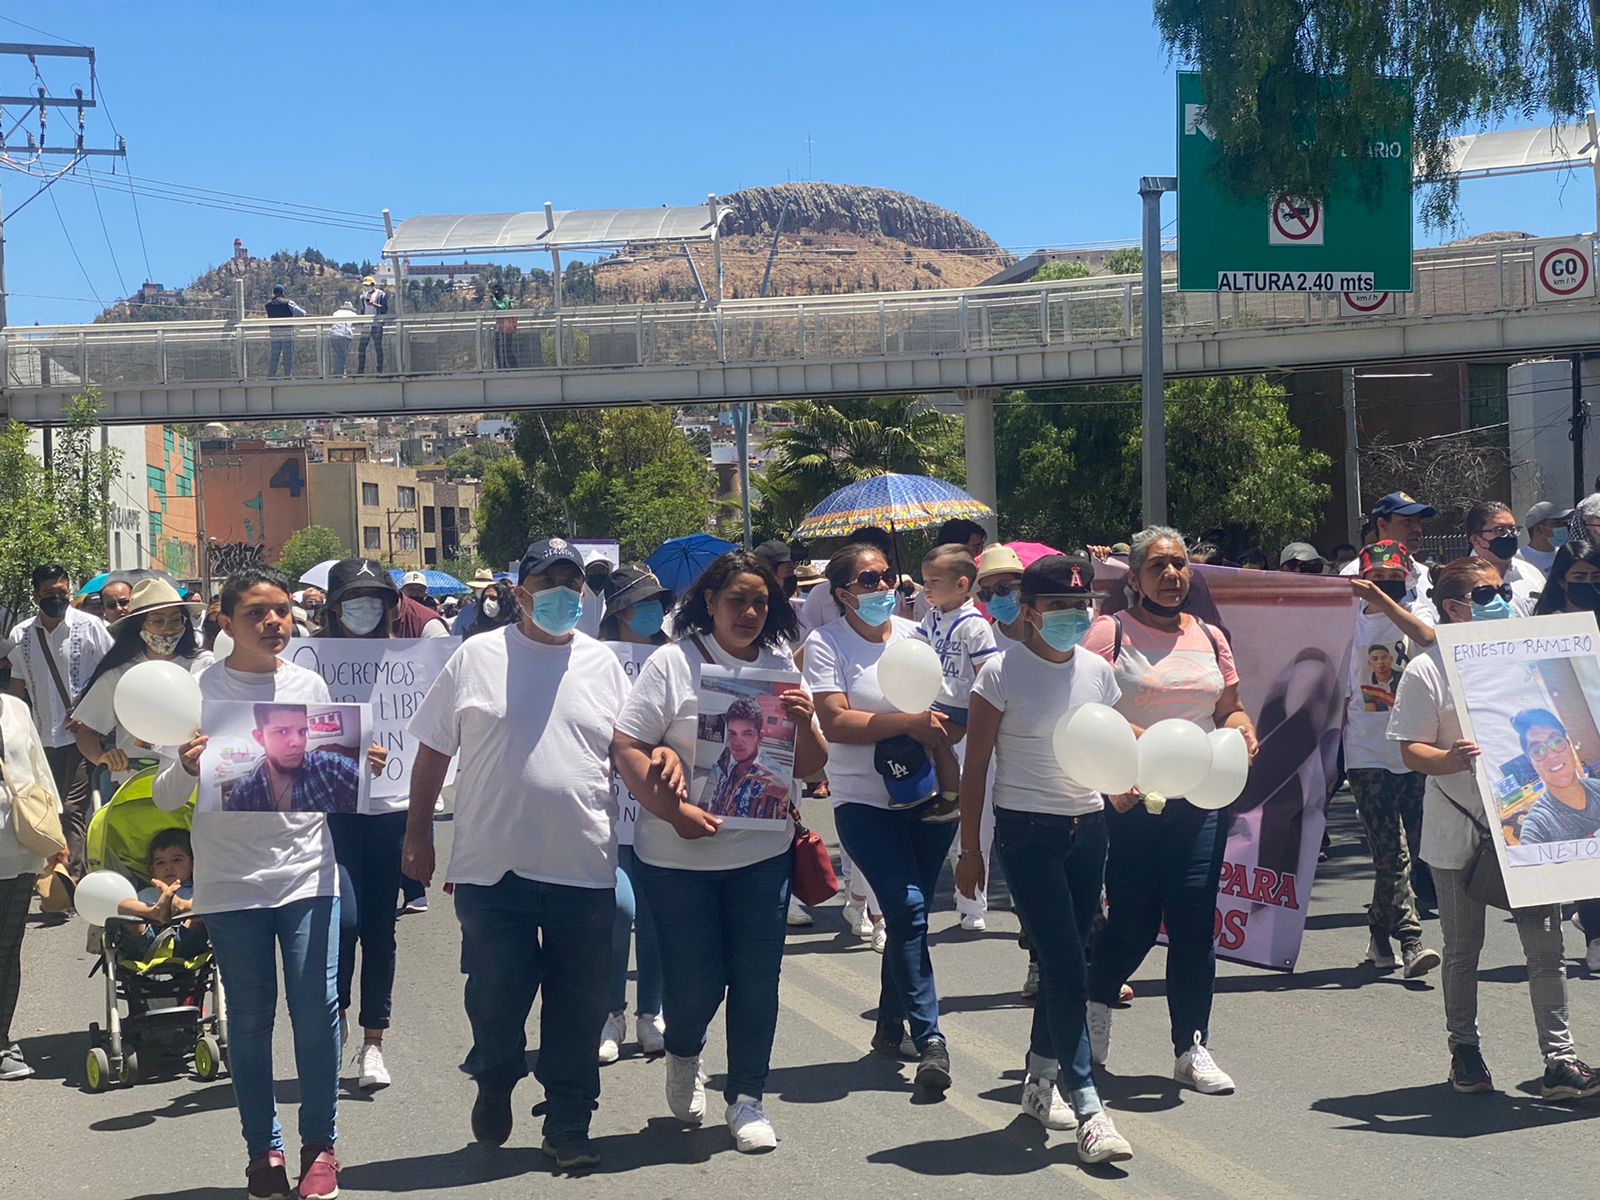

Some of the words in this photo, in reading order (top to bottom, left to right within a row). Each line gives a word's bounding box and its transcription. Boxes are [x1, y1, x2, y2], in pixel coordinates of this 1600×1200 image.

[1340, 273, 1373, 291] mts
[269, 458, 305, 498] 4
[1453, 641, 1516, 662] ERNESTO
[1523, 635, 1592, 654] RAMIRO
[886, 759, 910, 779] LA
[1538, 839, 1598, 862] NETO
[1217, 861, 1299, 911] PARA
